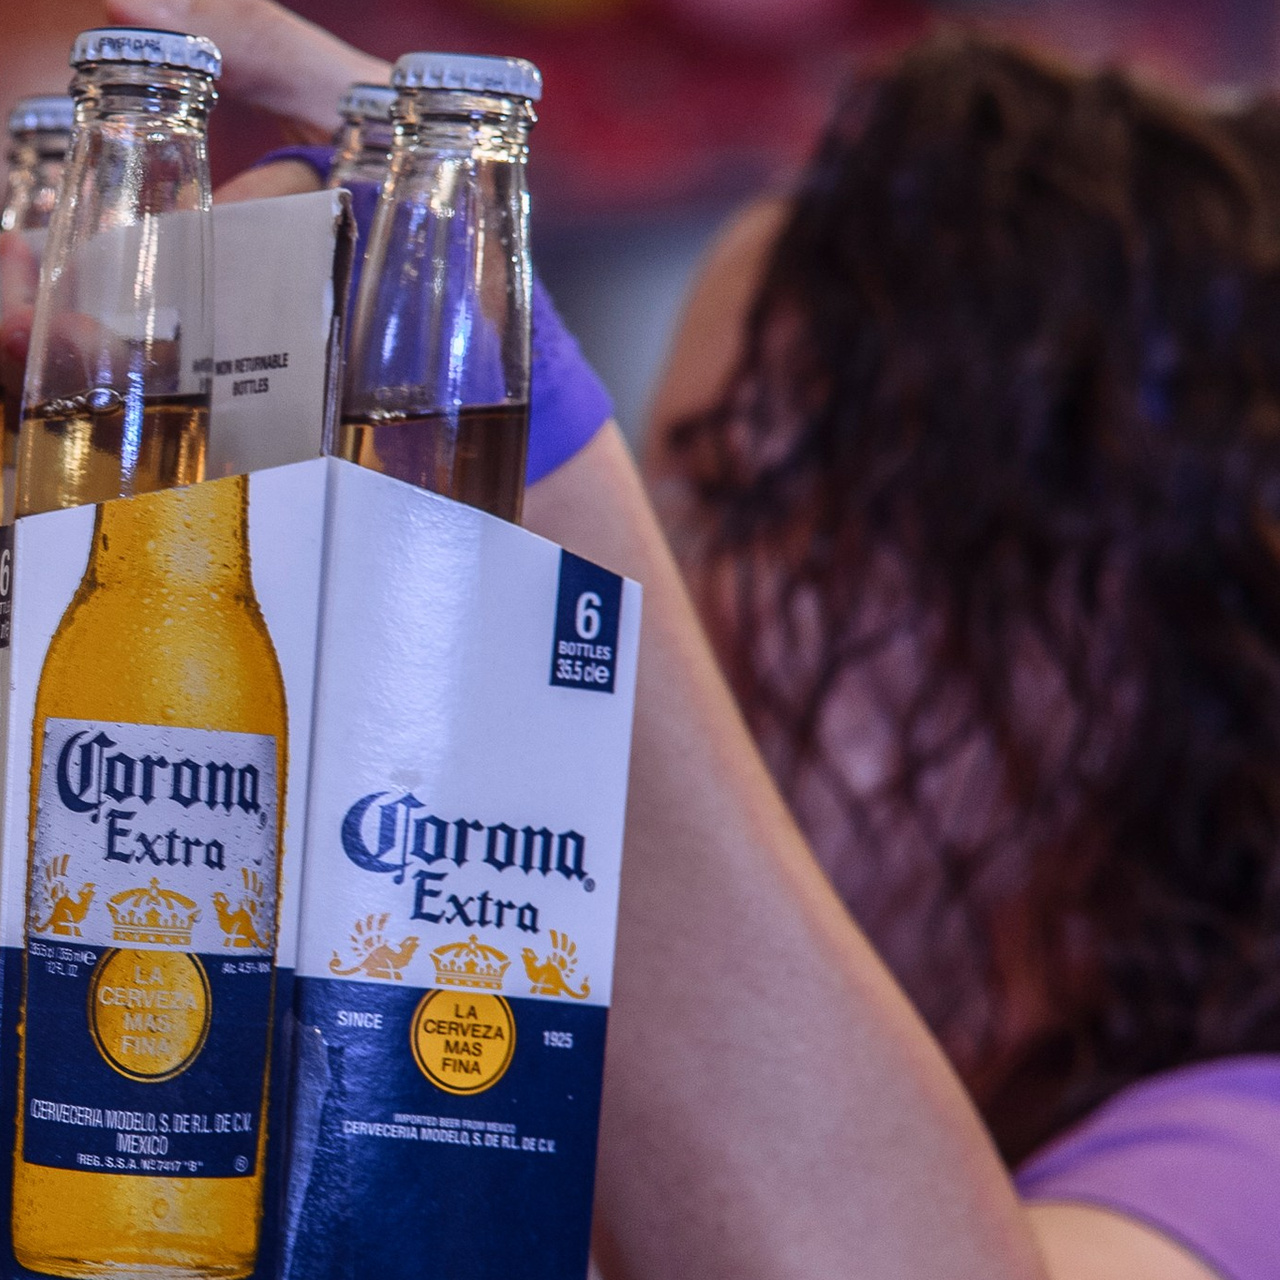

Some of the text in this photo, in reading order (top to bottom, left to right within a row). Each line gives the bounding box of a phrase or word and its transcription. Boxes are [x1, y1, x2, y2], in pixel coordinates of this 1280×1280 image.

[234, 353, 288, 373] RETURNABLE
[232, 378, 268, 396] BOTTLES
[0, 549, 10, 596] 6
[576, 592, 602, 639] 6
[558, 640, 613, 661] BOTTLES
[57, 730, 261, 824] Corona
[103, 808, 227, 871] Extra
[341, 791, 588, 885] Corona
[411, 870, 540, 934] Extra
[135, 966, 164, 985] LA
[99, 986, 198, 1010] CERVEZA
[337, 1010, 384, 1030] SINCE
[454, 1003, 478, 1020] LA
[123, 1013, 171, 1033] MAS
[423, 1019, 504, 1041] CERVEZA
[120, 1035, 170, 1056] FINA
[444, 1039, 483, 1057] MAS
[543, 1030, 573, 1049] 1925
[442, 1058, 482, 1075] FINA
[30, 1098, 104, 1129] CERVECERIA
[172, 1113, 190, 1134] DE
[214, 1113, 231, 1134] DE
[116, 1133, 169, 1156] MEXICO
[343, 1120, 418, 1140] CERVECERIA
[484, 1133, 500, 1148] DE
[522, 1136, 537, 1152] DE
